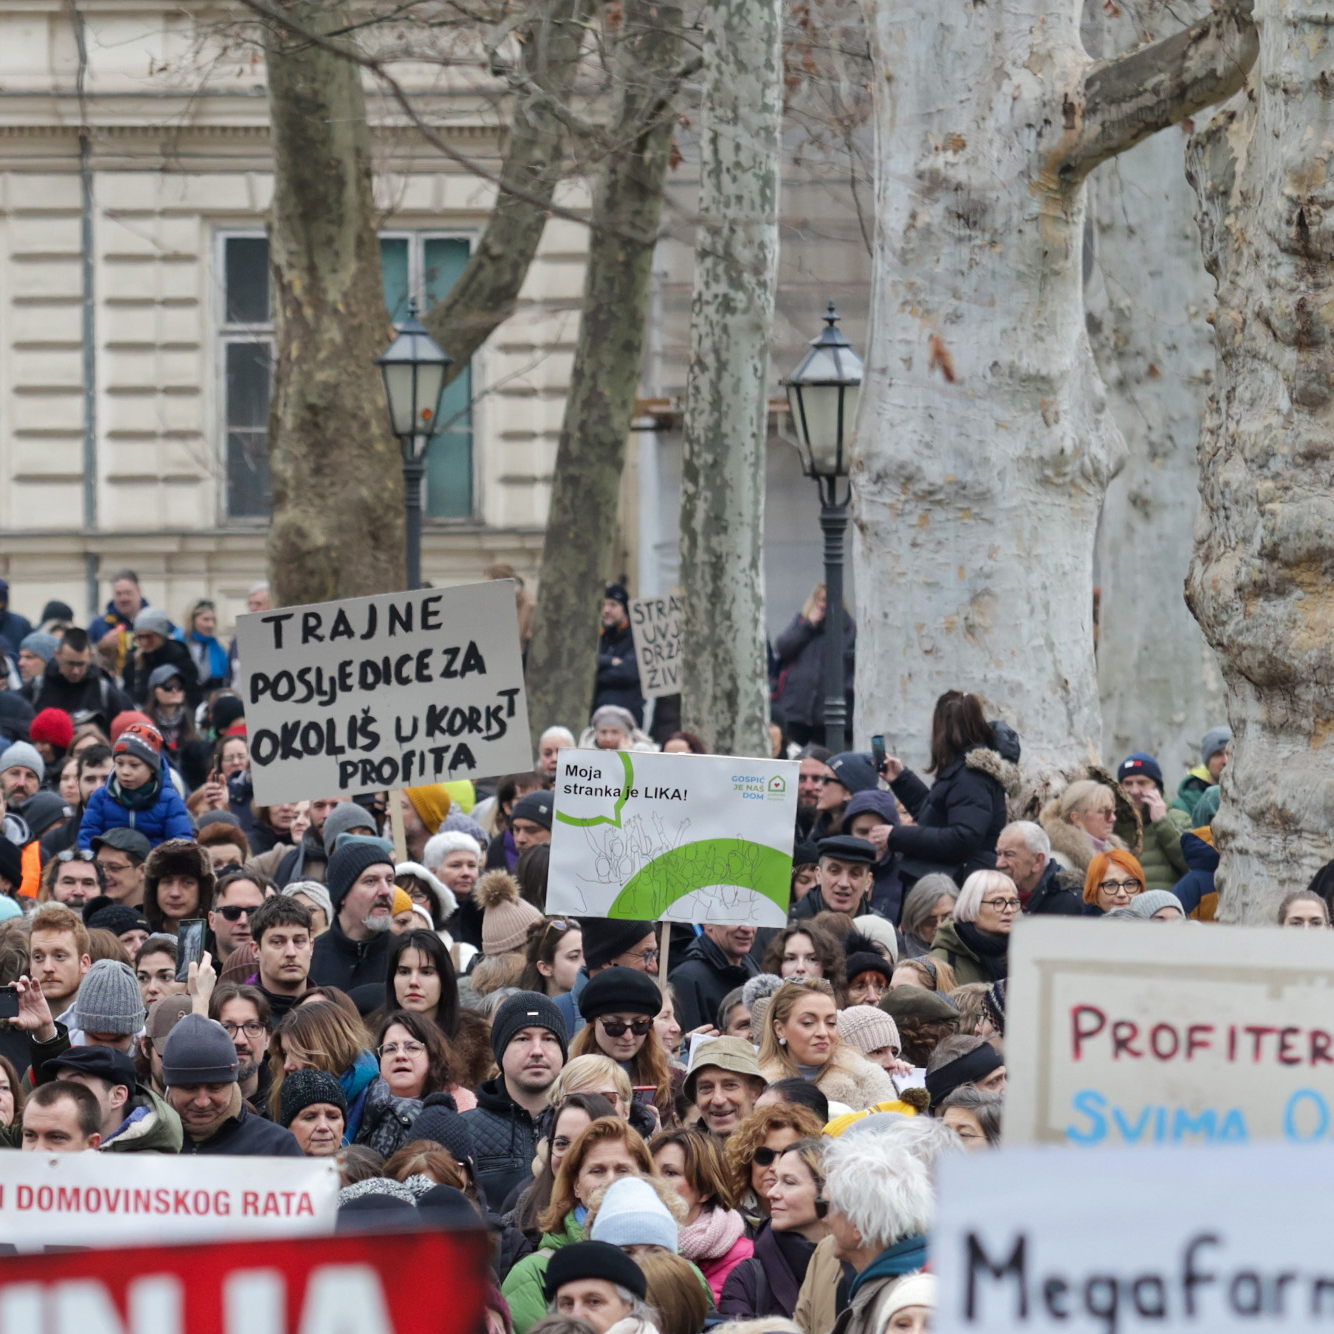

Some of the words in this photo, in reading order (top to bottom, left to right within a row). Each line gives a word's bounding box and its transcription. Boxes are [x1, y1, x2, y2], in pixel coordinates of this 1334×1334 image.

[261, 595, 443, 649] TRAJNE
[250, 649, 433, 706] POSLJEDICE
[439, 641, 487, 678] ZA
[250, 706, 381, 766] OKOLIŠ
[395, 715, 418, 745] U
[425, 688, 520, 742] KORIST
[339, 743, 476, 789] PROFITA
[565, 765, 602, 781] Moja
[563, 783, 621, 798] stranka
[625, 787, 639, 801] je
[644, 787, 688, 801] LIKA!
[731, 776, 765, 784] GOSPIĆ
[746, 784, 764, 792] NAŠ
[742, 792, 764, 800] DOM
[17, 1185, 230, 1216] DOMOVINSKOG
[242, 1190, 315, 1217] RATA
